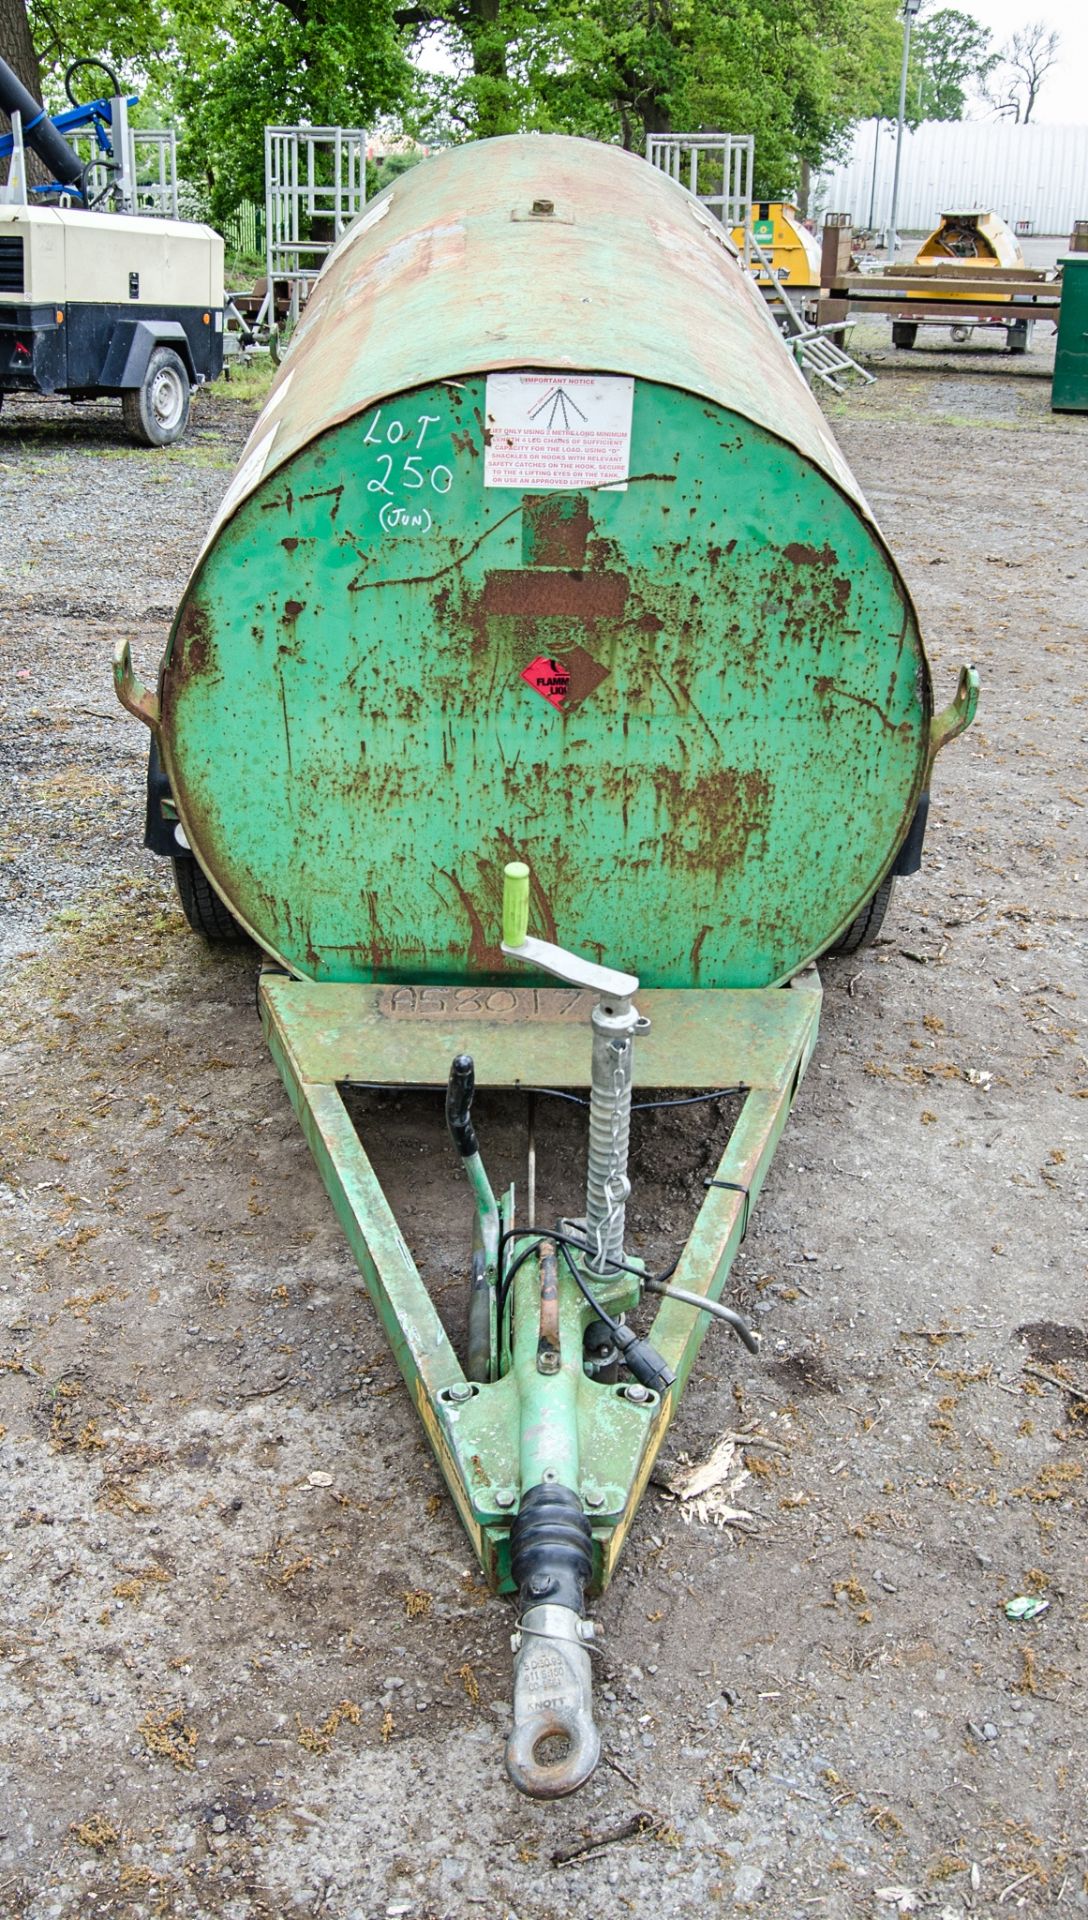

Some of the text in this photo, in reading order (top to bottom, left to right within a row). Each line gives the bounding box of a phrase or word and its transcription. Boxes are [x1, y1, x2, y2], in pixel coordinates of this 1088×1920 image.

[363, 409, 441, 449] LOT
[367, 454, 453, 495] 250
[528, 1697, 567, 1710] KNOTT
